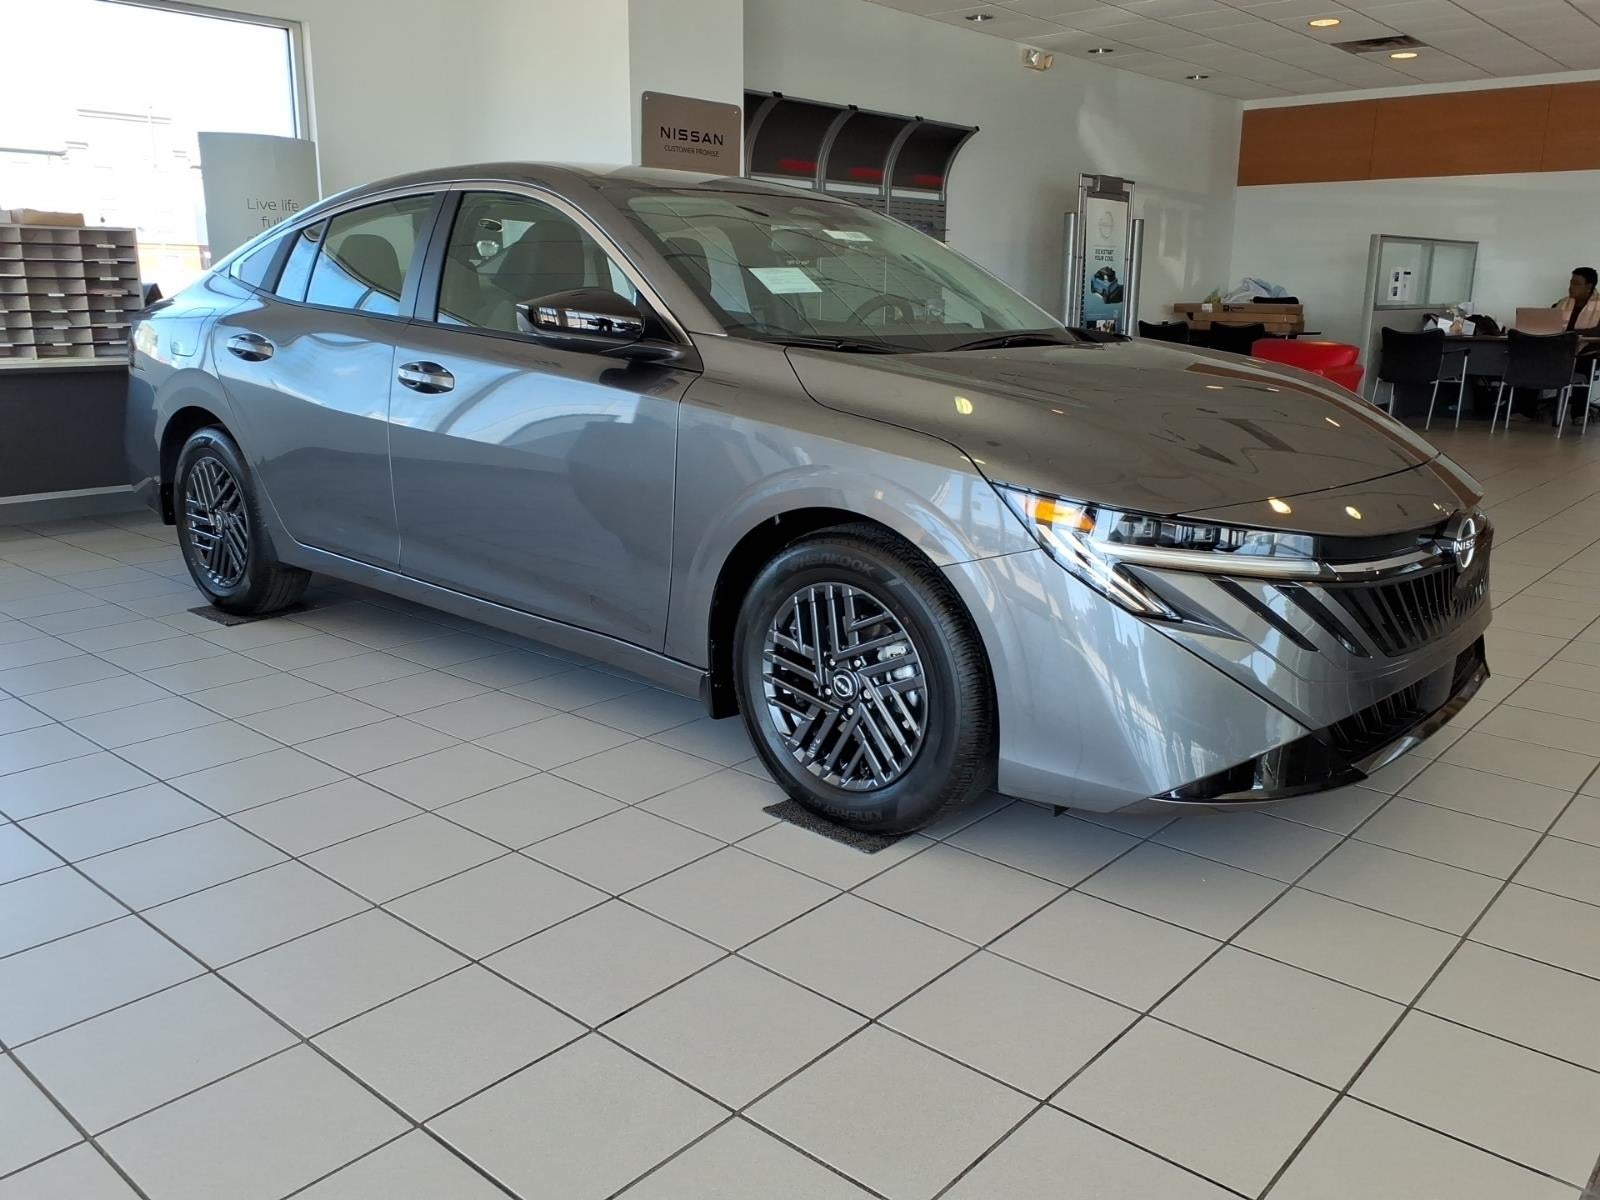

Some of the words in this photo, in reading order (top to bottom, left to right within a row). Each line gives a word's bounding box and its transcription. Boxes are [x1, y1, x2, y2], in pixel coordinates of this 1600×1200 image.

[660, 126, 724, 146] NISSAN
[664, 145, 695, 154] CUSTOMER
[246, 198, 277, 211] Live
[281, 199, 299, 212] life
